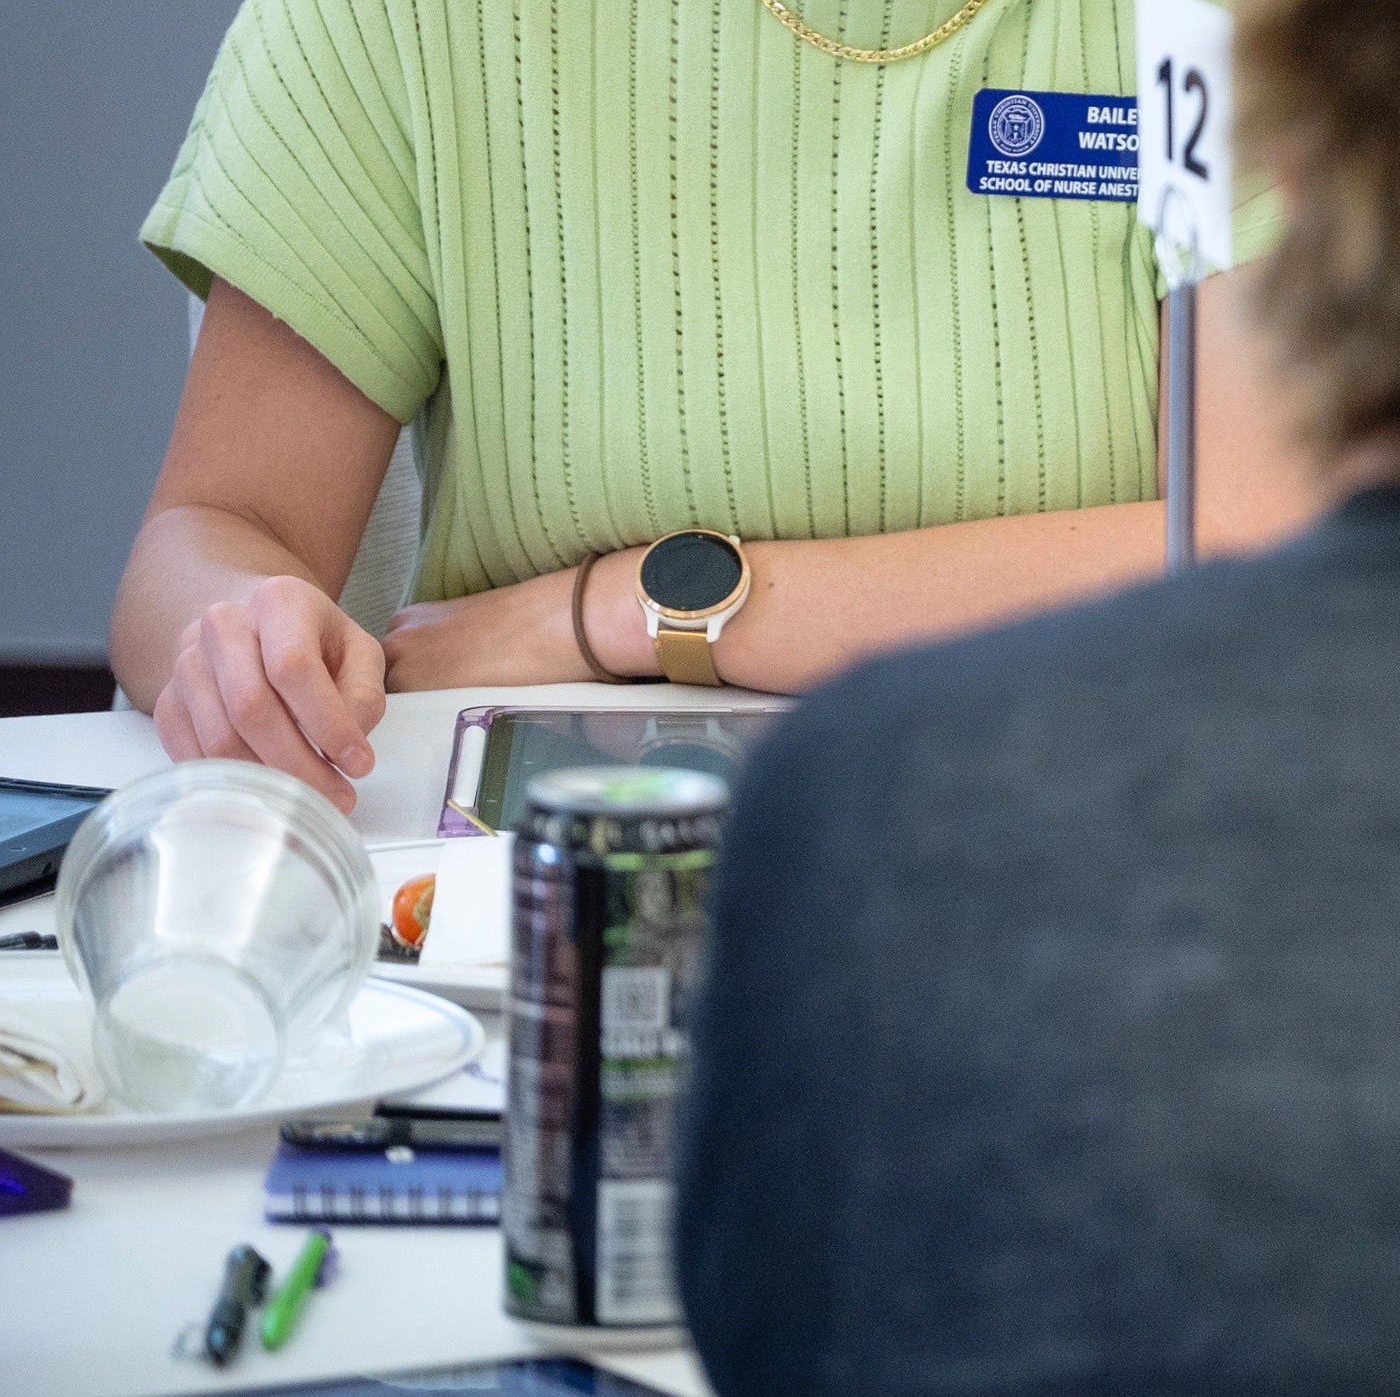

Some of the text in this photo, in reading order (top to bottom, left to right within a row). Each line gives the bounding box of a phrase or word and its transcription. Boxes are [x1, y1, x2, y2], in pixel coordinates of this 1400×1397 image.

[1087, 106, 1140, 126] BAILE
[1157, 54, 1210, 181] 12
[1078, 131, 1140, 152] WATSO
[986, 160, 1140, 181] TEXAS CHRISTIAN UNIVE
[979, 177, 1139, 197] SCHOOL OF NURSE ANEST
